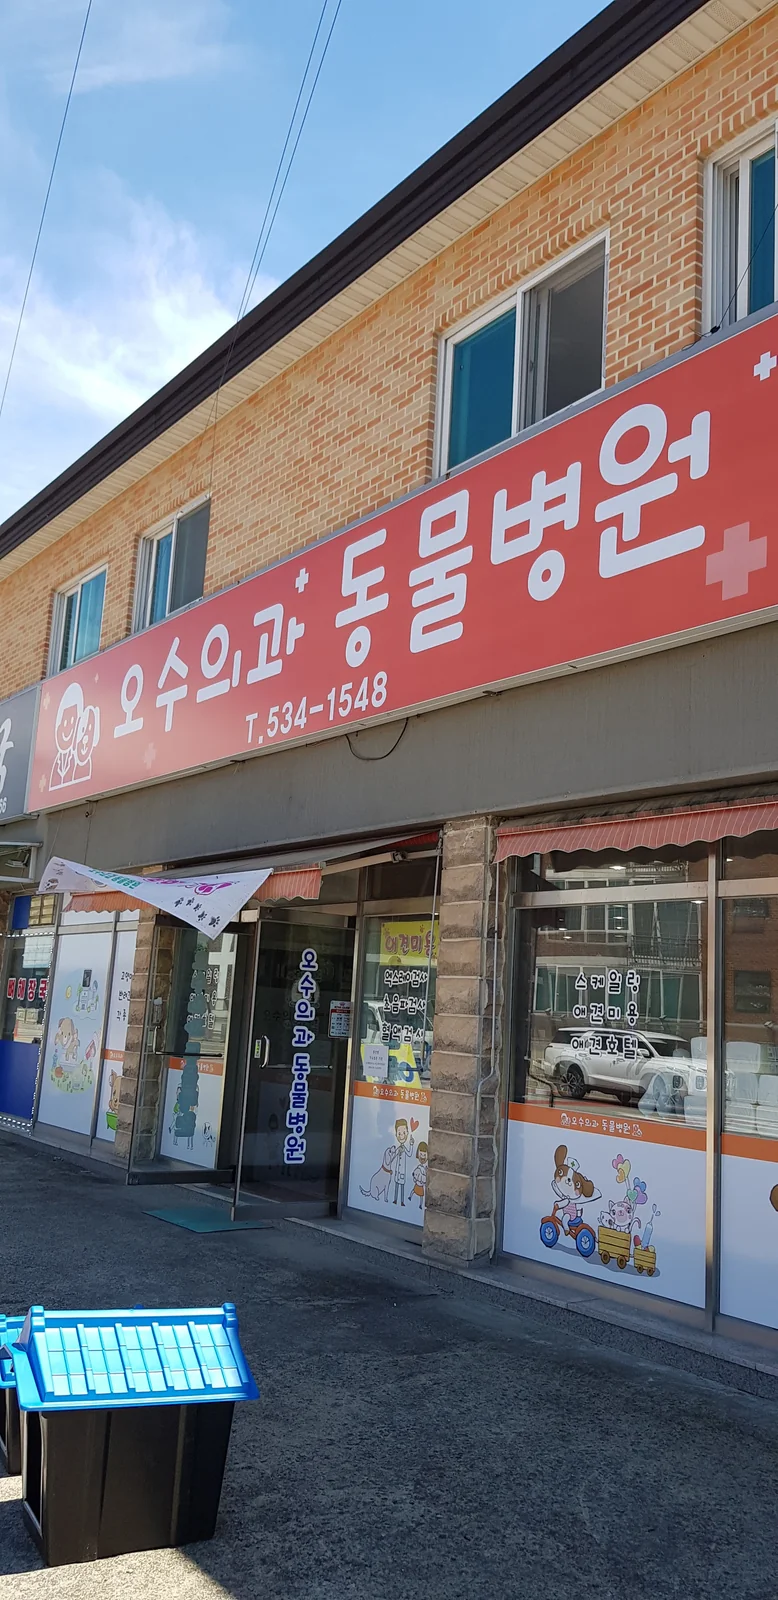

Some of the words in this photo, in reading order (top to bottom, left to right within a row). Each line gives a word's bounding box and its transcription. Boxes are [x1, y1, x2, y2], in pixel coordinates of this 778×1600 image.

[113, 603, 305, 738] 오수의과
[334, 403, 711, 668] 동물병원
[245, 670, 388, 744] T.534-1548
[575, 968, 640, 994] 스케일링
[292, 948, 318, 1047] 오수의과
[383, 993, 426, 1014] 초음파검사
[573, 1002, 639, 1026] 애견미용
[381, 1021, 424, 1043] 혈액검사
[571, 1035, 639, 1060] 애견호텔
[284, 1052, 310, 1164] 동물병원
[571, 1116, 599, 1128] 오수의과
[601, 1119, 631, 1135] 동물병원
